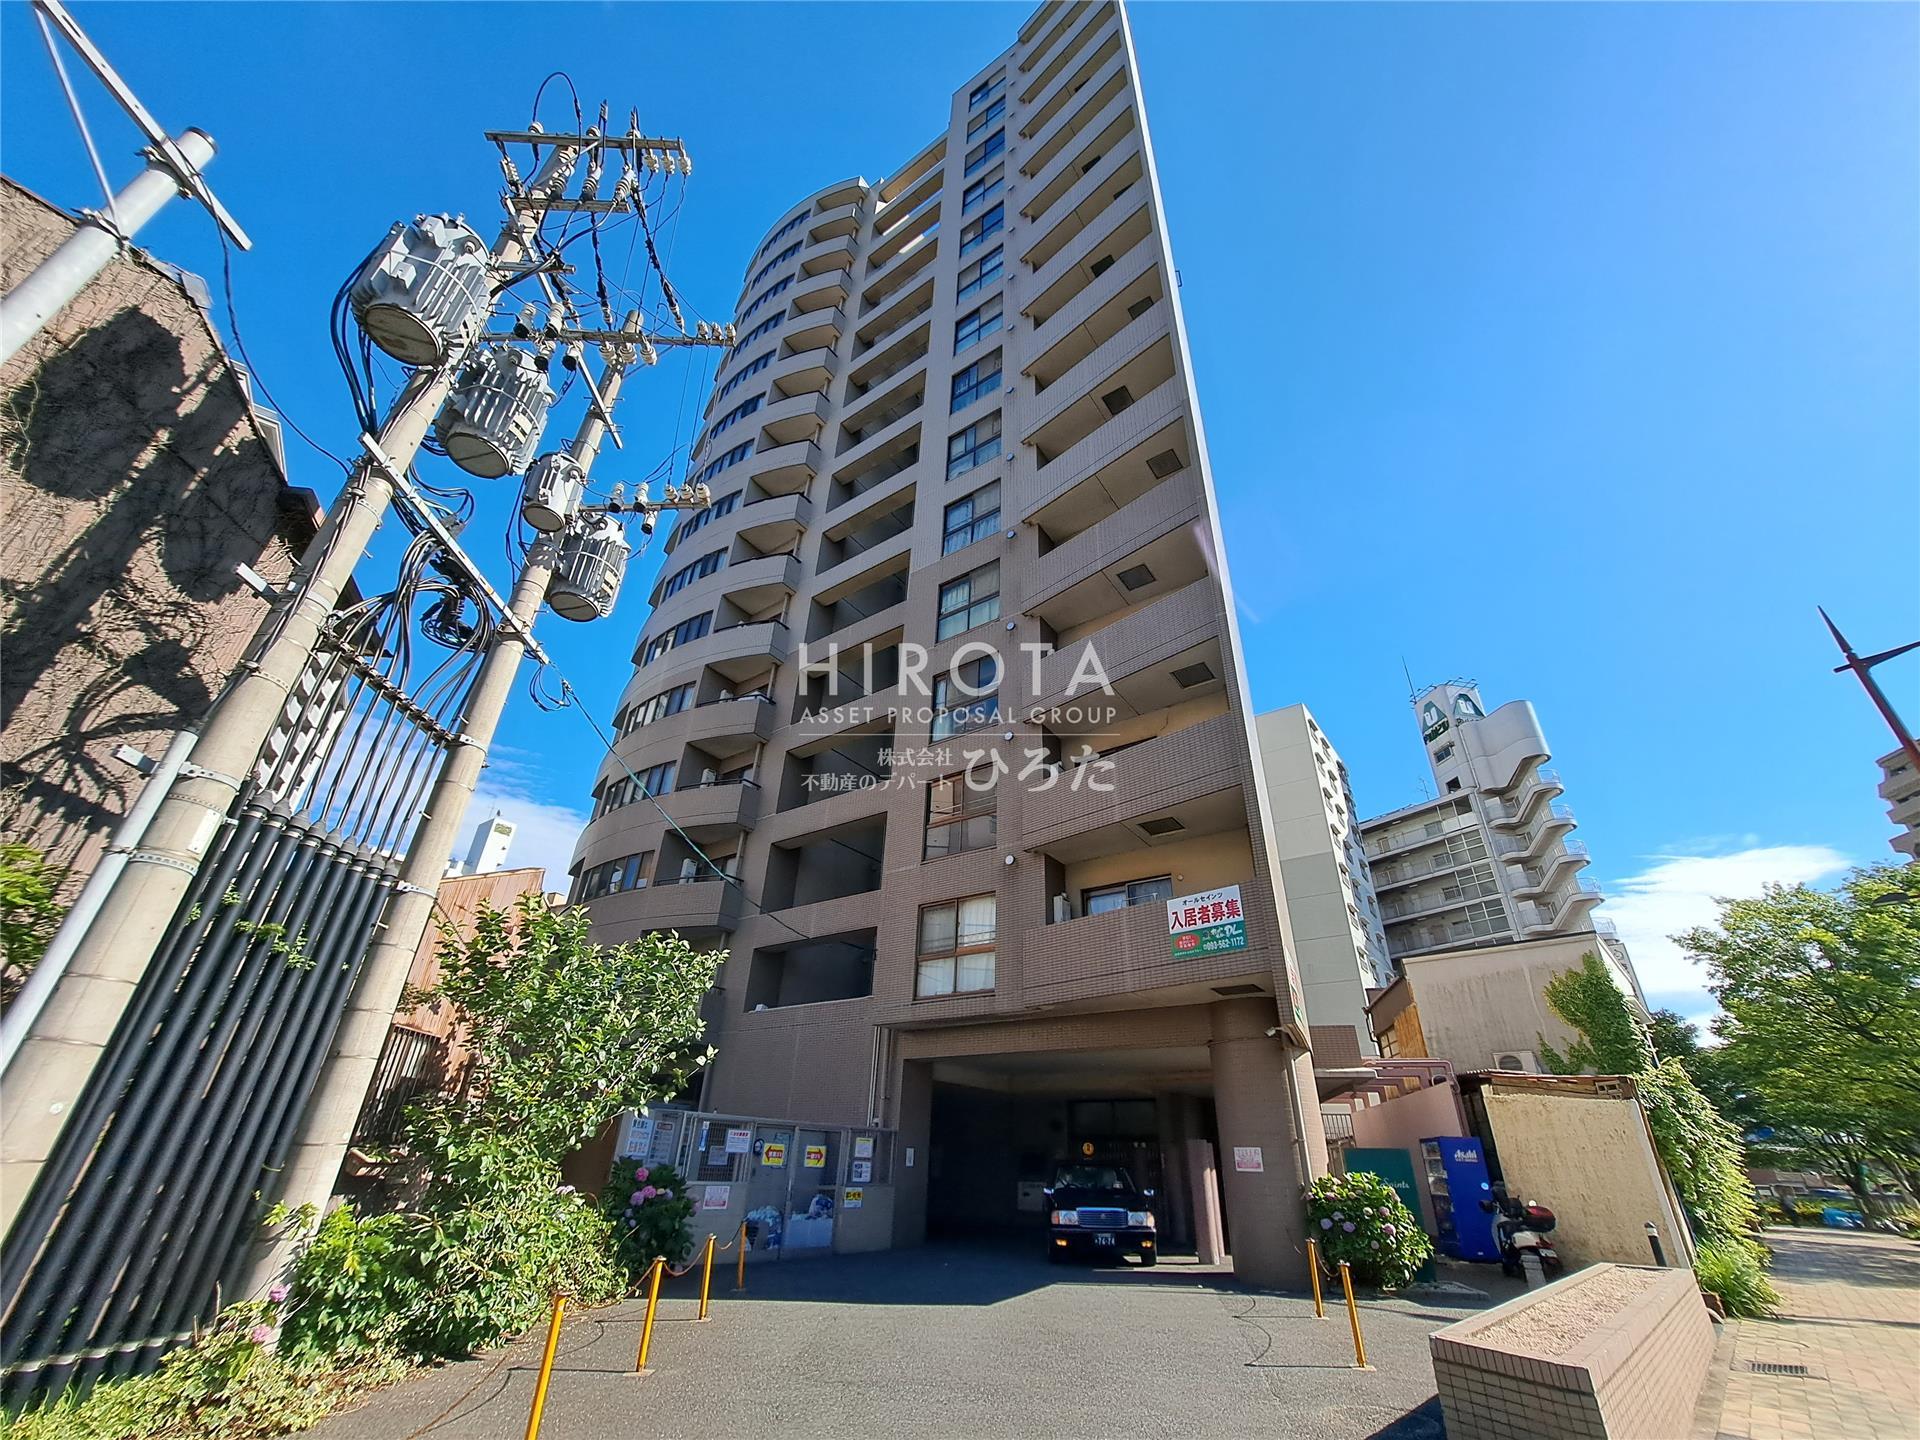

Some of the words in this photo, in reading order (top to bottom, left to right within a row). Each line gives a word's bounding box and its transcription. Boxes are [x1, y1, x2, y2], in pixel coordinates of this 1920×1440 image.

[1171, 898, 1241, 930] 入居者募集
